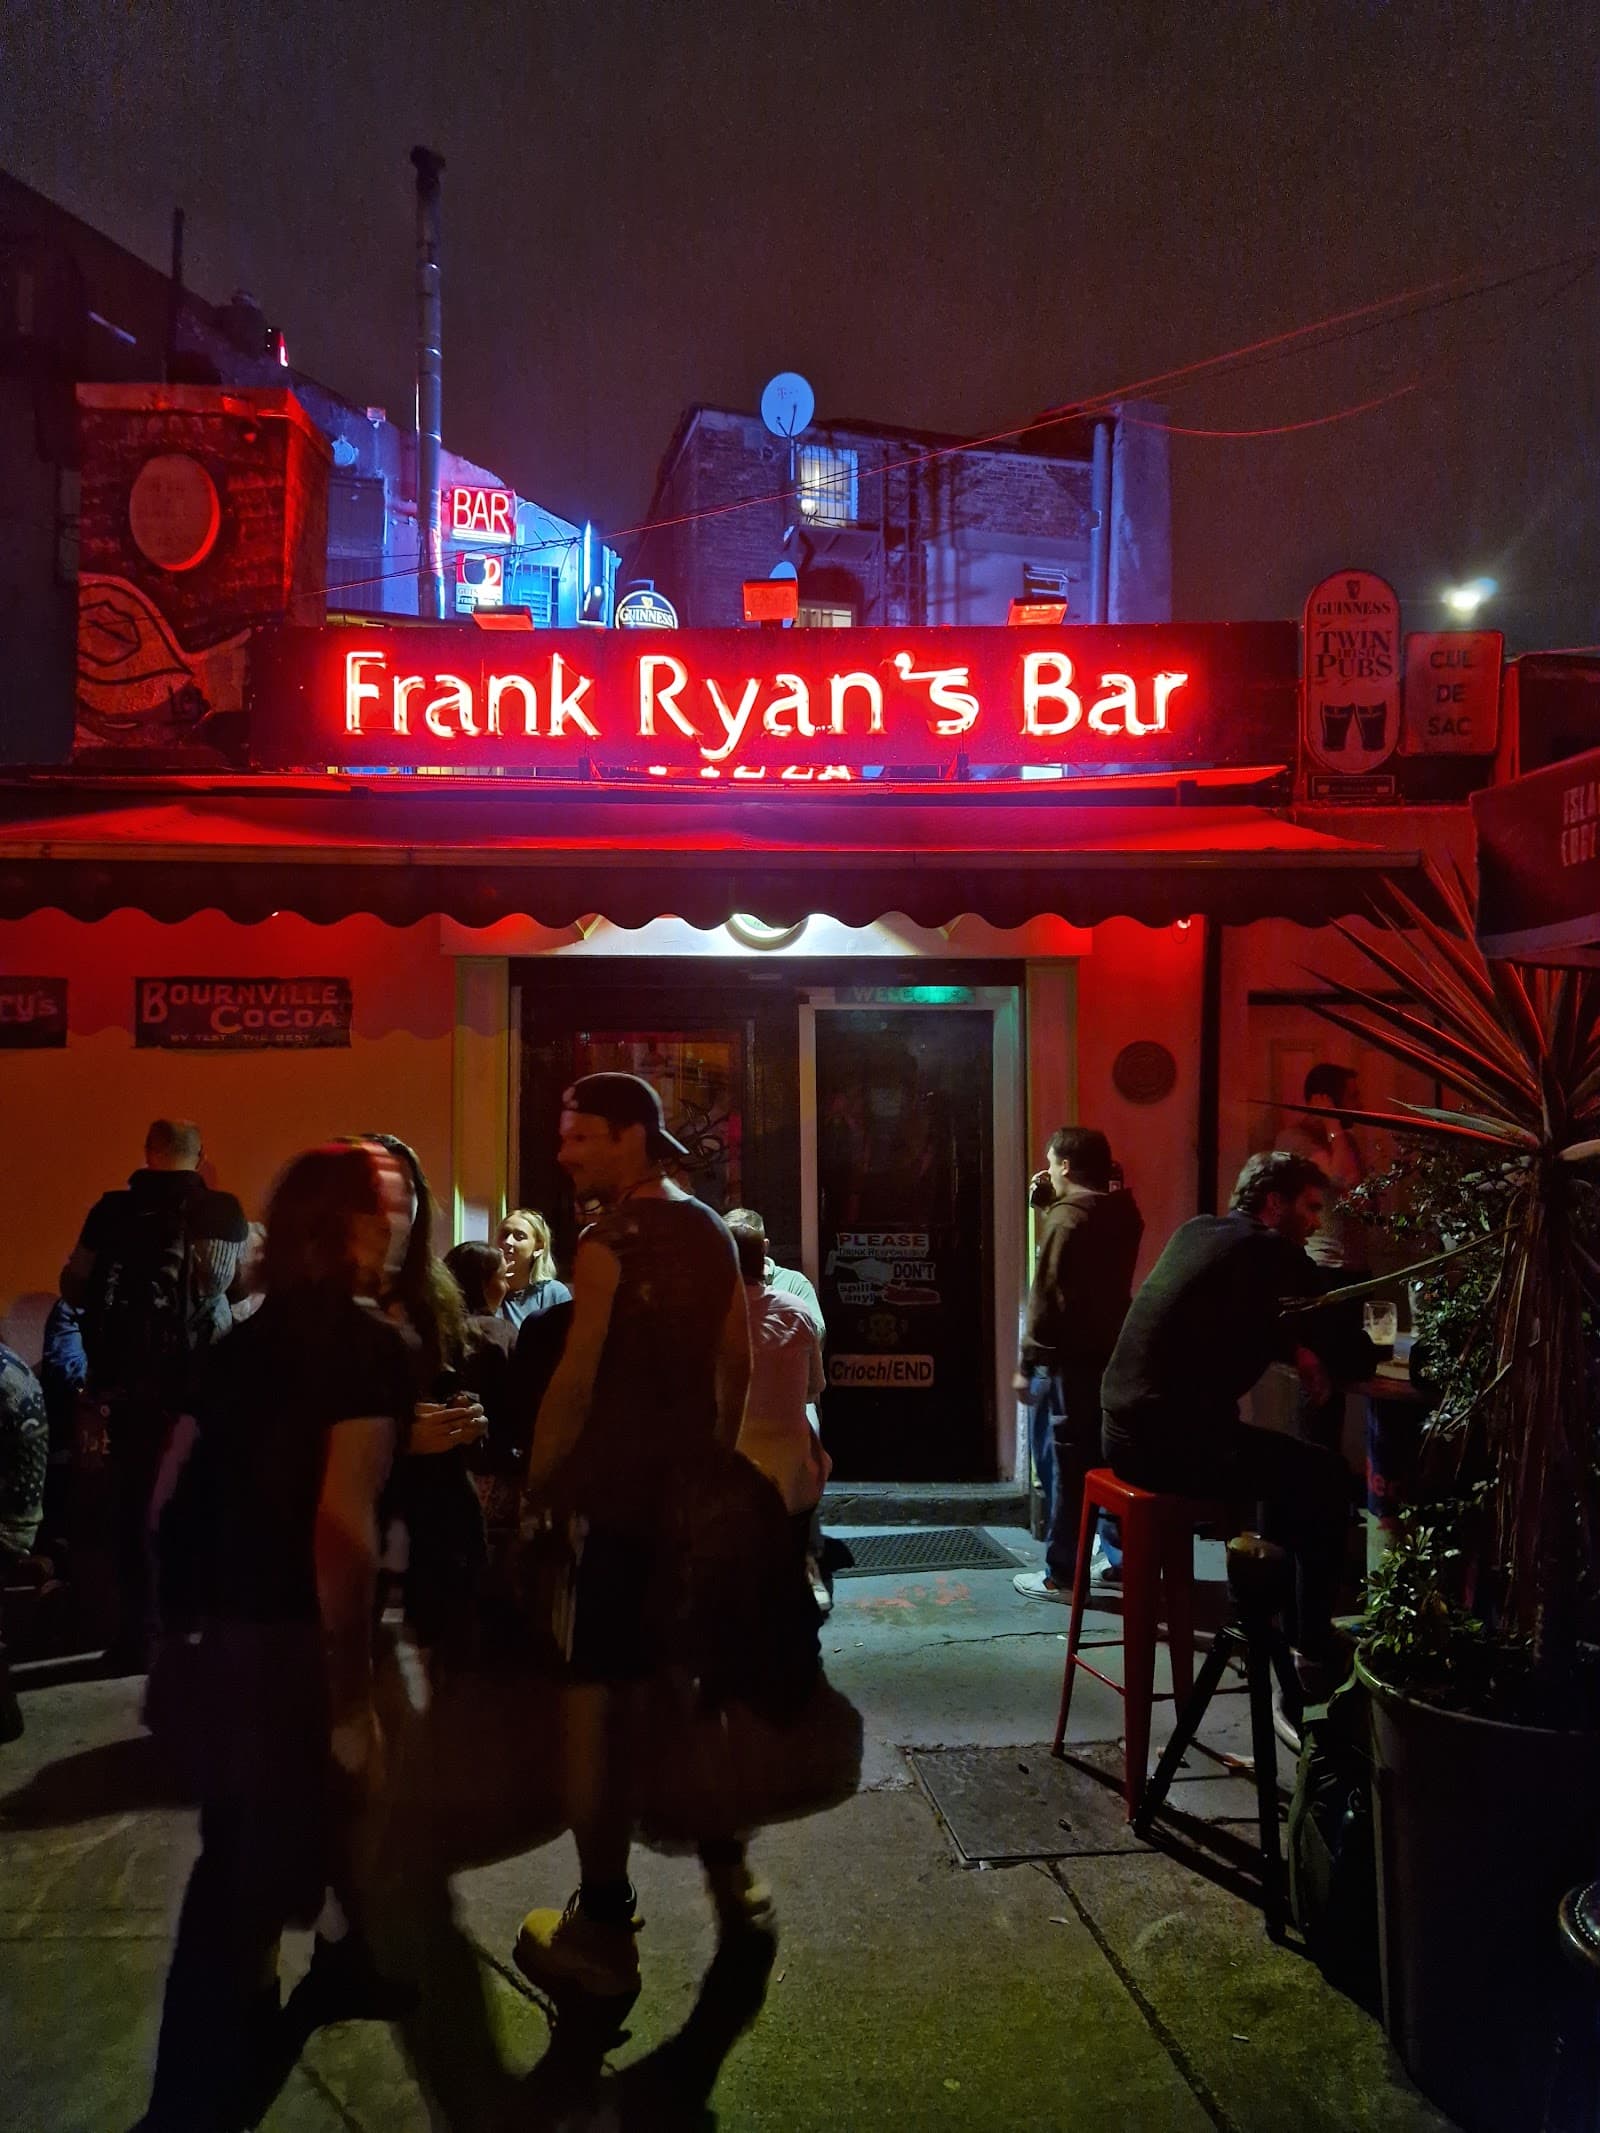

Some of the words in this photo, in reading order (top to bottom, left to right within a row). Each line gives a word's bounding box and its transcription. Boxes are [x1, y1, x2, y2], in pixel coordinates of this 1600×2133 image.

[453, 488, 510, 535] BAR
[620, 607, 674, 626] GUINNESS
[1317, 602, 1391, 615] GUINNESS
[1316, 630, 1392, 653] TWIN
[1316, 653, 1393, 678] PUBS
[1430, 650, 1475, 669] CUL
[1436, 683, 1466, 703] DE
[345, 650, 600, 738] Frank
[638, 651, 980, 761] Ryan's
[1021, 651, 1188, 736] Bar
[1428, 716, 1472, 736] SAC
[210, 1004, 337, 1035] COCOA
[839, 1234, 927, 1247] PLEASE
[894, 1262, 935, 1279] DON'T
